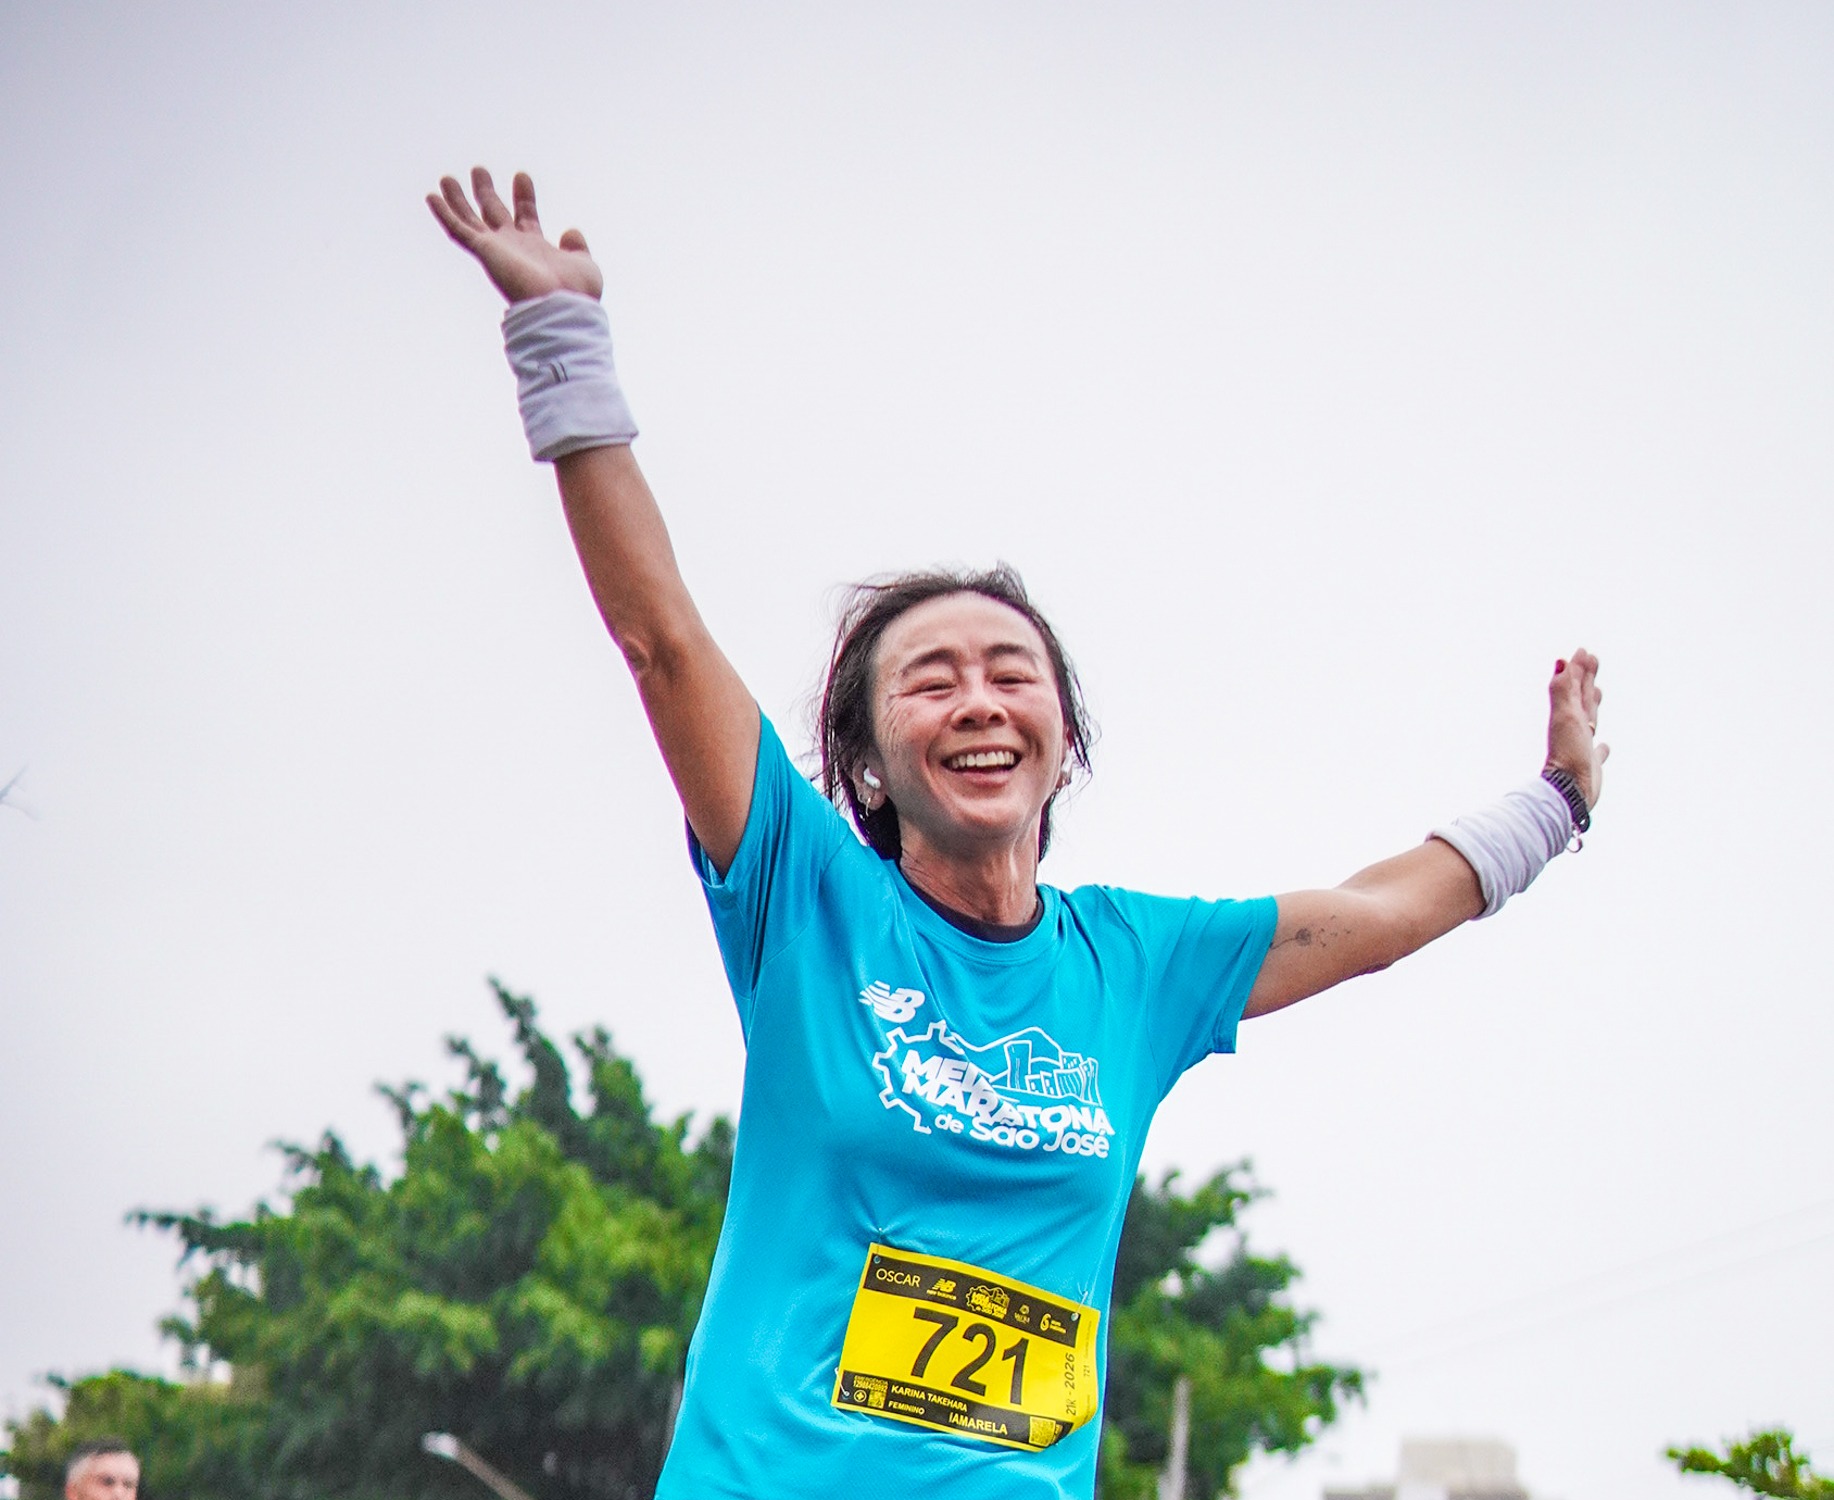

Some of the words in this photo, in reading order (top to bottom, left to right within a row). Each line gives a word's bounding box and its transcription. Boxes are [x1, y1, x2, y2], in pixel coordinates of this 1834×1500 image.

[901, 1072, 1115, 1136] MARATONA
[934, 1113, 964, 1134] de
[969, 1114, 1040, 1150] São
[1042, 1122, 1110, 1158] José
[876, 1268, 921, 1288] OSCAR
[911, 1307, 1029, 1406] 721
[1064, 1352, 1076, 1390] 2026
[888, 1401, 925, 1416] FEMININO
[891, 1385, 926, 1401] KARINA
[927, 1393, 968, 1413] TAKEHARA
